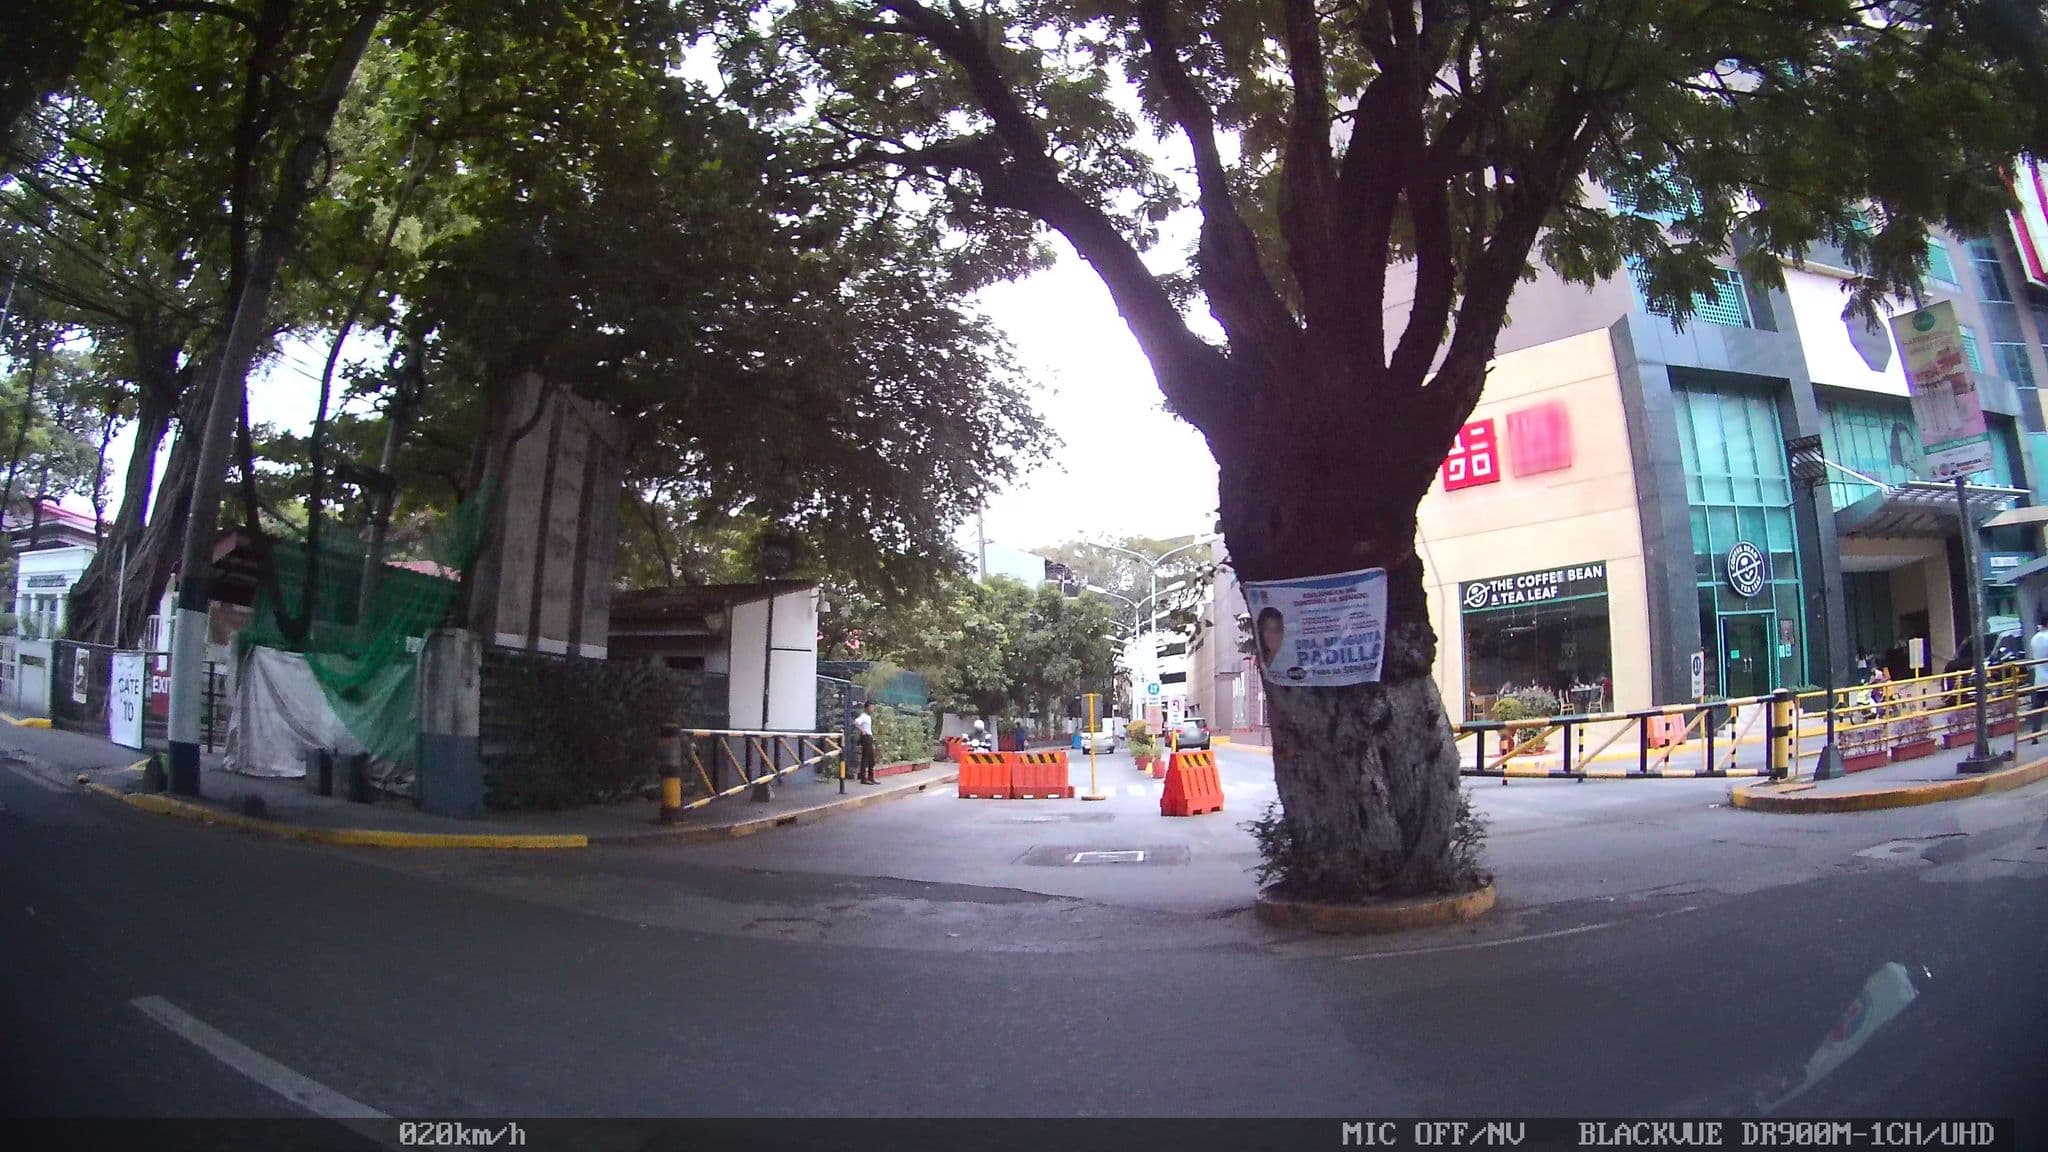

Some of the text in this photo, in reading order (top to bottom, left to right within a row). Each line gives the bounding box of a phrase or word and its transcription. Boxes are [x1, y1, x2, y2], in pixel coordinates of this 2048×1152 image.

[1490, 565, 1603, 592] THE COFFEE BEAN
[1500, 591, 1525, 605] TEA
[1527, 586, 1558, 601] LEAF
[118, 677, 139, 695] GATE
